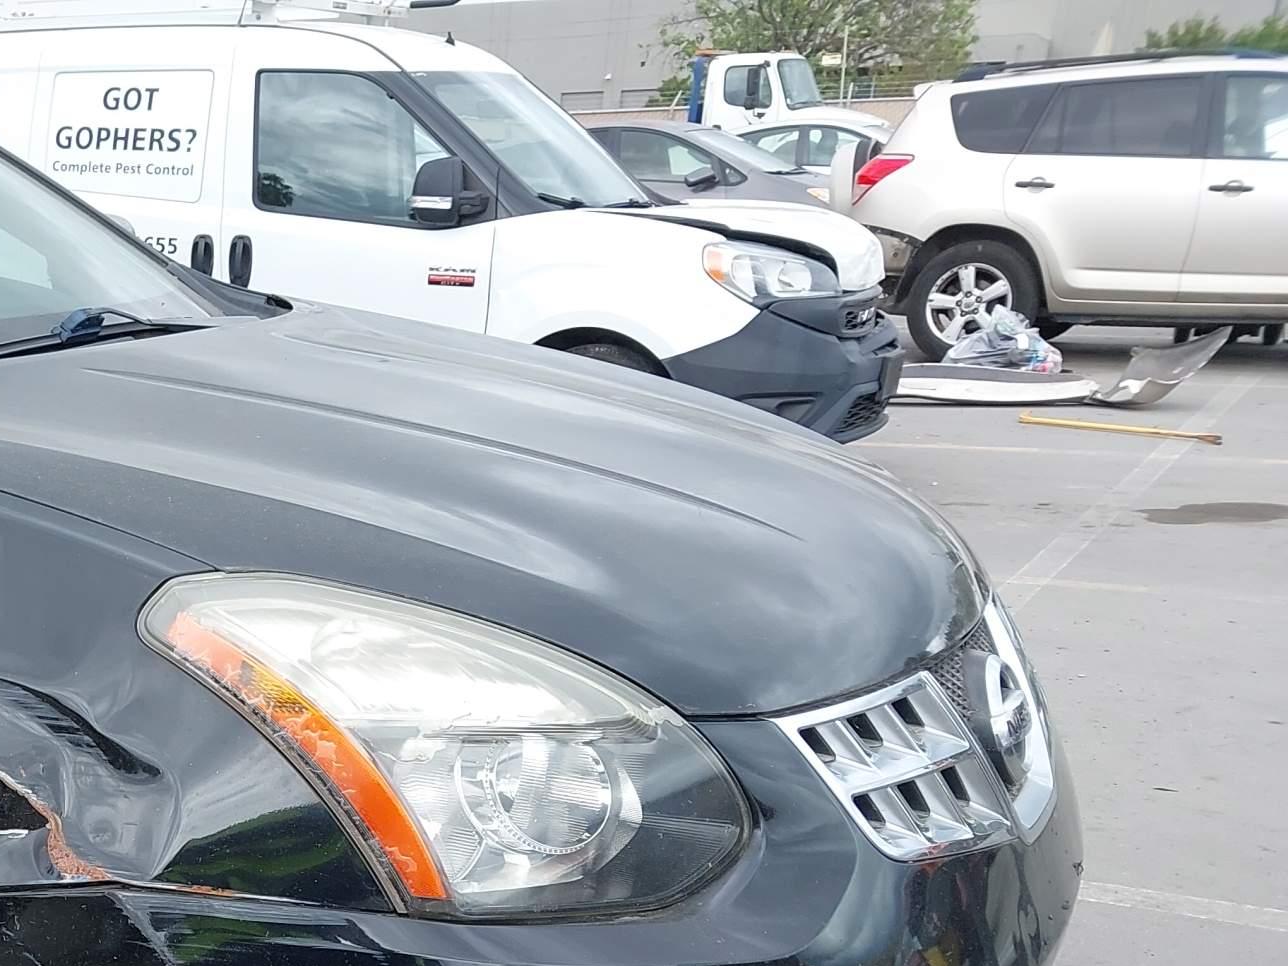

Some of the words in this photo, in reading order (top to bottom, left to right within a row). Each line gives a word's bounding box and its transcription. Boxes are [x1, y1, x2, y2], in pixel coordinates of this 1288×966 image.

[103, 87, 159, 111] GOT
[56, 126, 197, 153] GOPHERS?
[52, 160, 111, 175] Complete
[115, 163, 141, 175] Pest
[145, 163, 194, 177] Control
